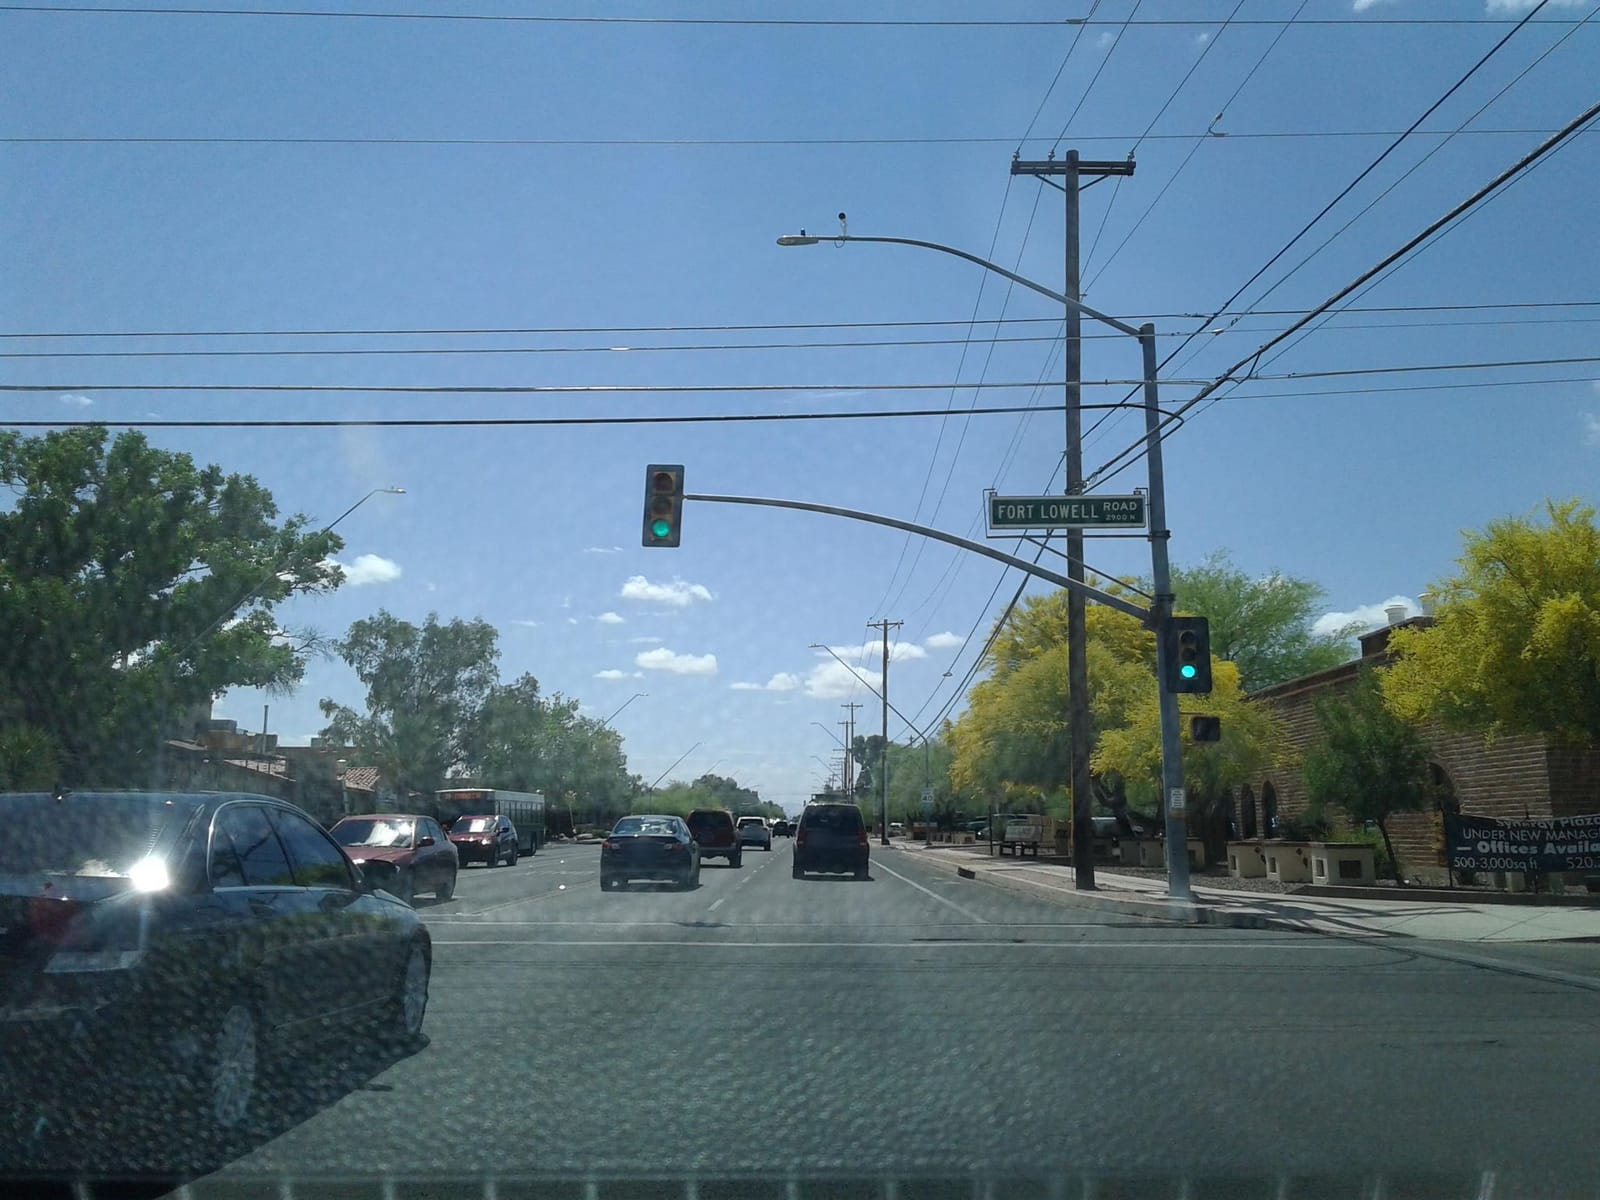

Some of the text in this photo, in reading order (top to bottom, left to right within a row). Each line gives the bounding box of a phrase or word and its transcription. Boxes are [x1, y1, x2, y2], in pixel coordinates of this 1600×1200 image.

[998, 501, 1137, 520] FORT LOWELL ROAD
[922, 794, 933, 802] 40
[1462, 827, 1600, 841] UNDER NEW MANAG
[1477, 840, 1538, 854] Offices
